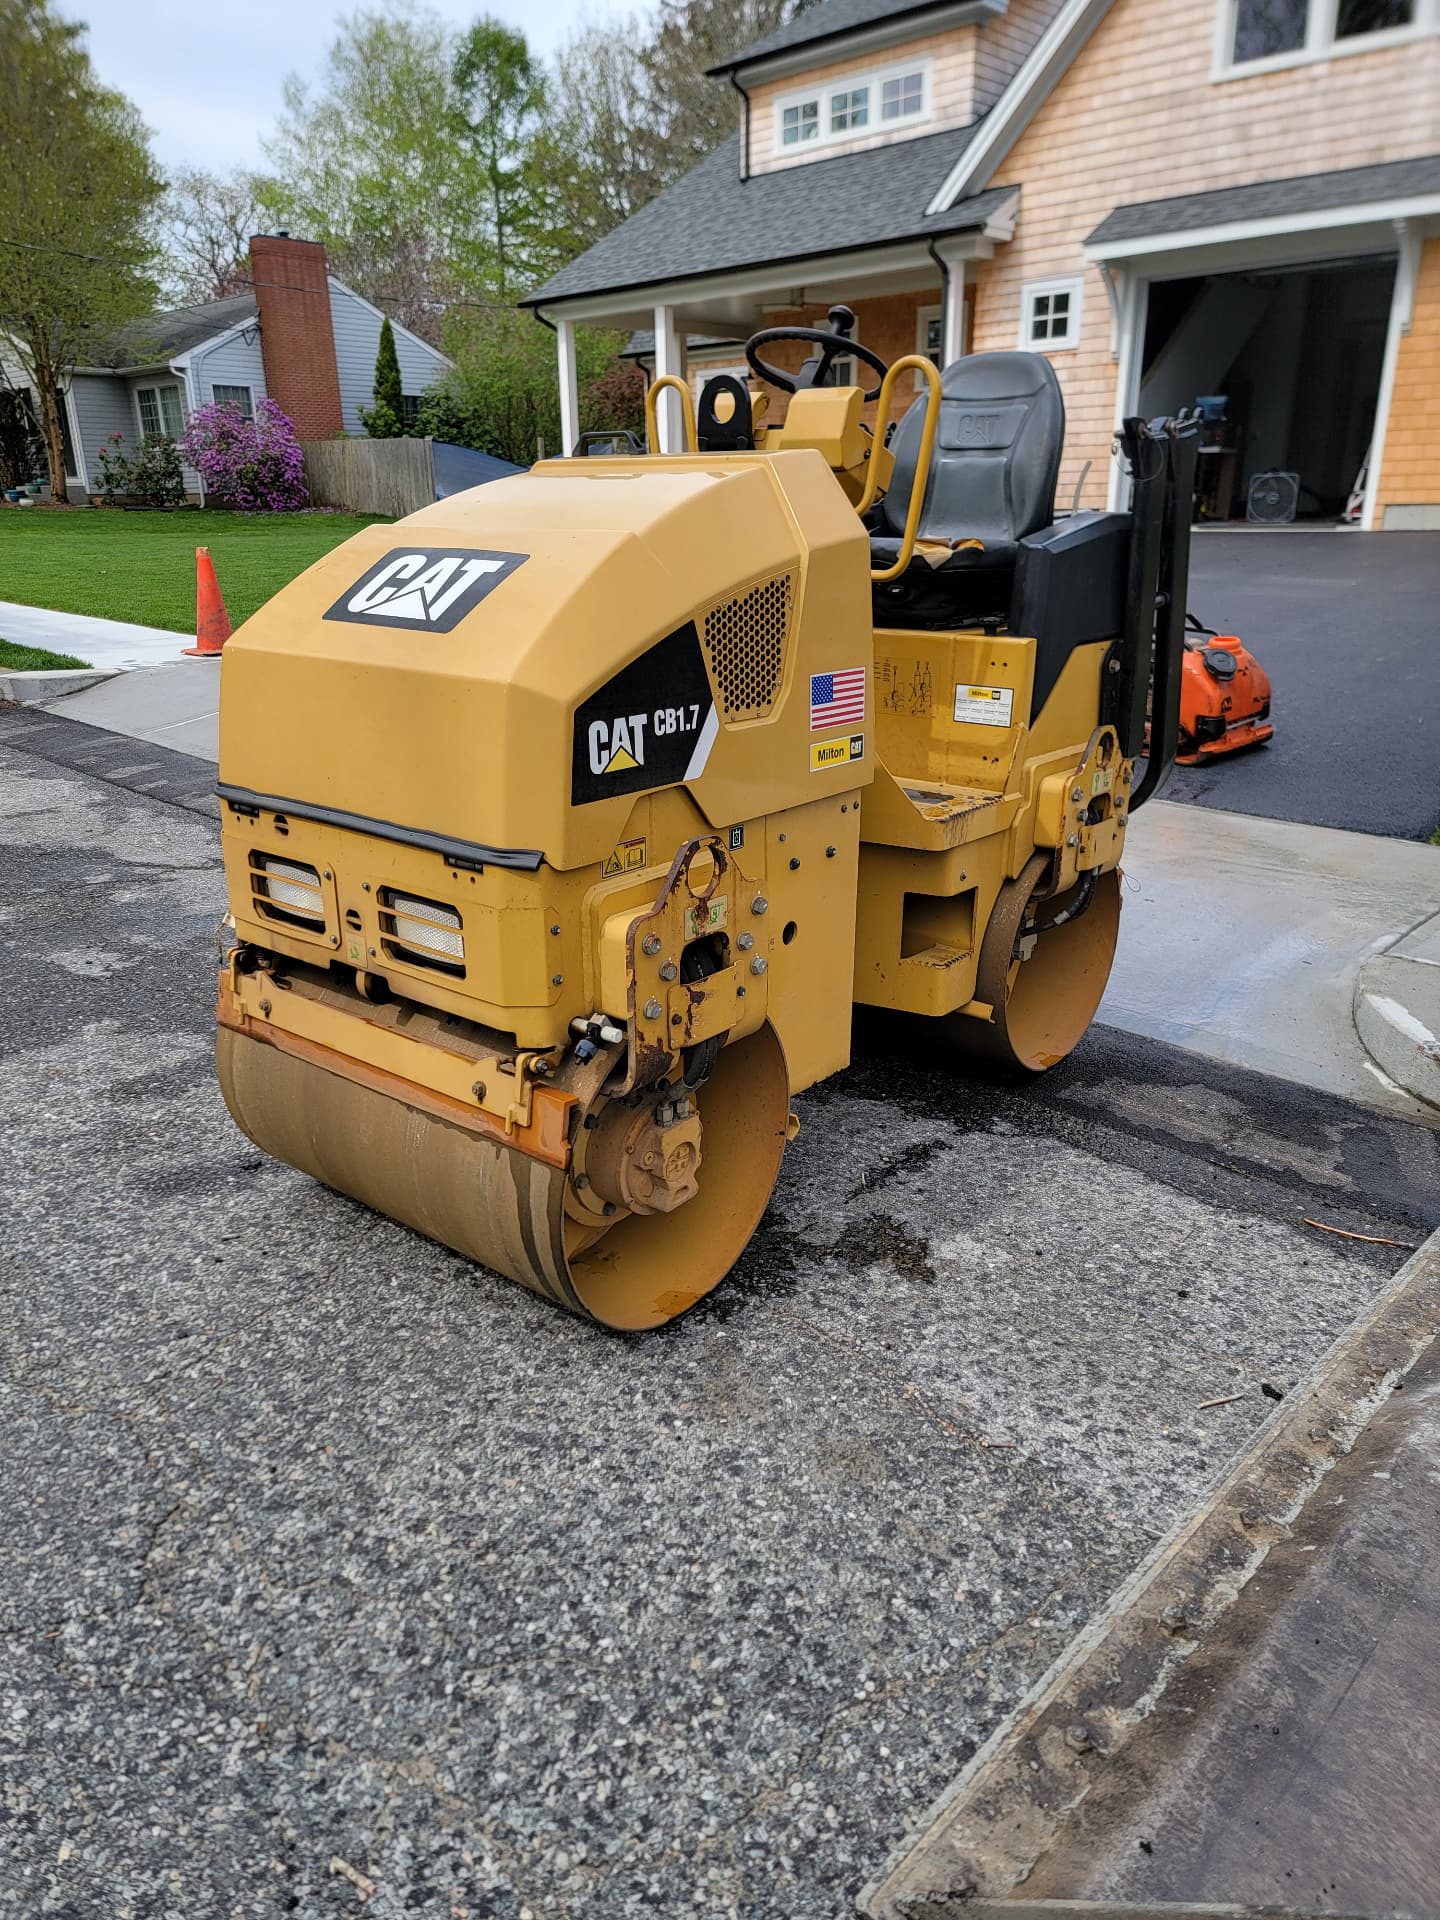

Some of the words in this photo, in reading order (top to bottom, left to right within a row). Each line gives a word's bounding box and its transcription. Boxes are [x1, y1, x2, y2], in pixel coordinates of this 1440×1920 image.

[958, 413, 1000, 443] CAT
[348, 554, 506, 621] CAT
[588, 713, 648, 774] CAT
[653, 704, 699, 736] CB1.7
[817, 747, 844, 761] Milton
